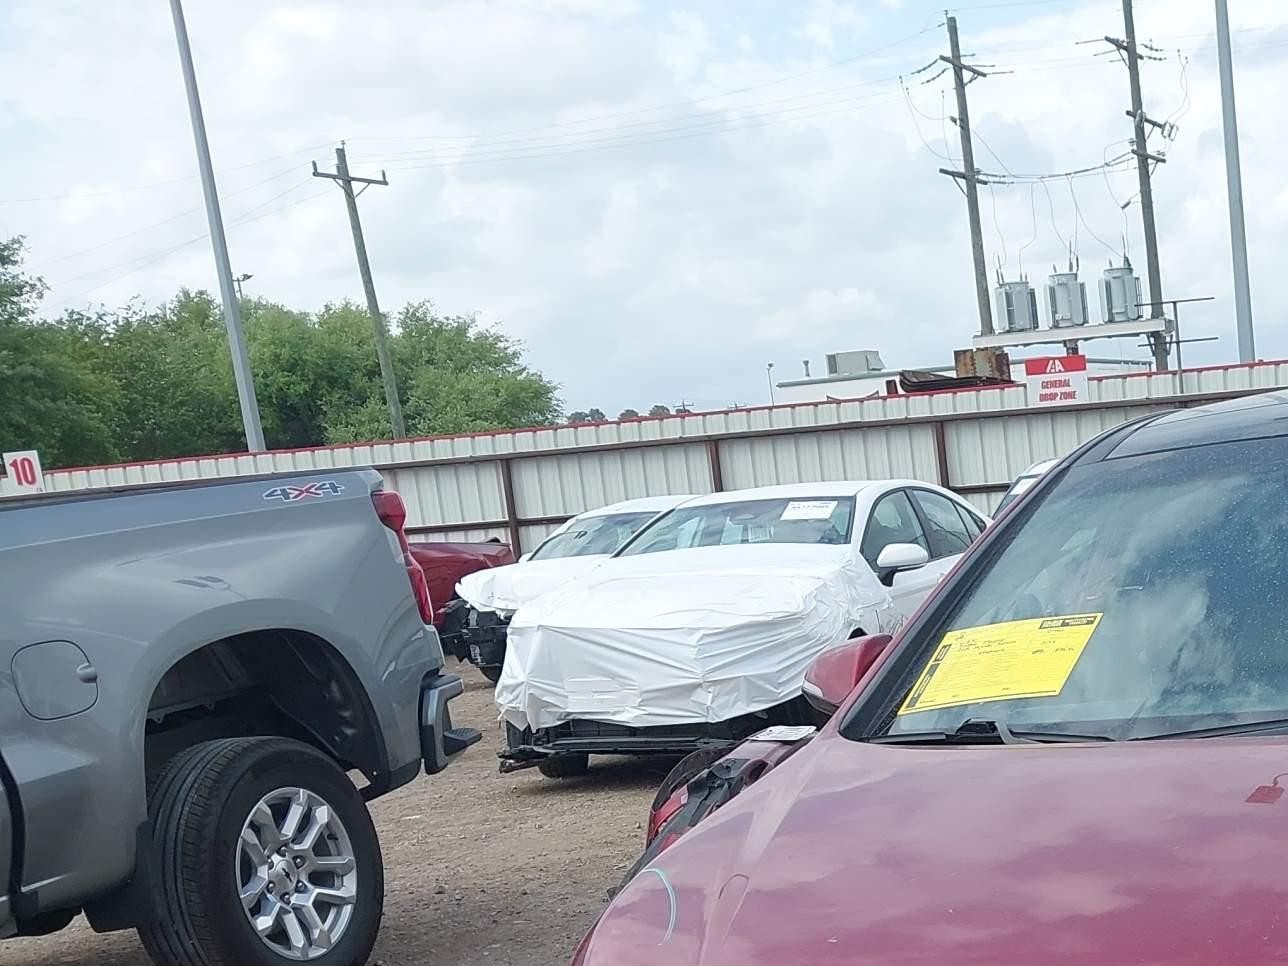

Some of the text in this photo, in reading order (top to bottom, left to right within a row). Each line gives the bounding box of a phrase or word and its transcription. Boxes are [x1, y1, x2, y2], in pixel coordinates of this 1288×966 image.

[1041, 378, 1071, 390] GENERAL
[1039, 390, 1077, 402] DROP ZONE
[9, 457, 37, 486] 10
